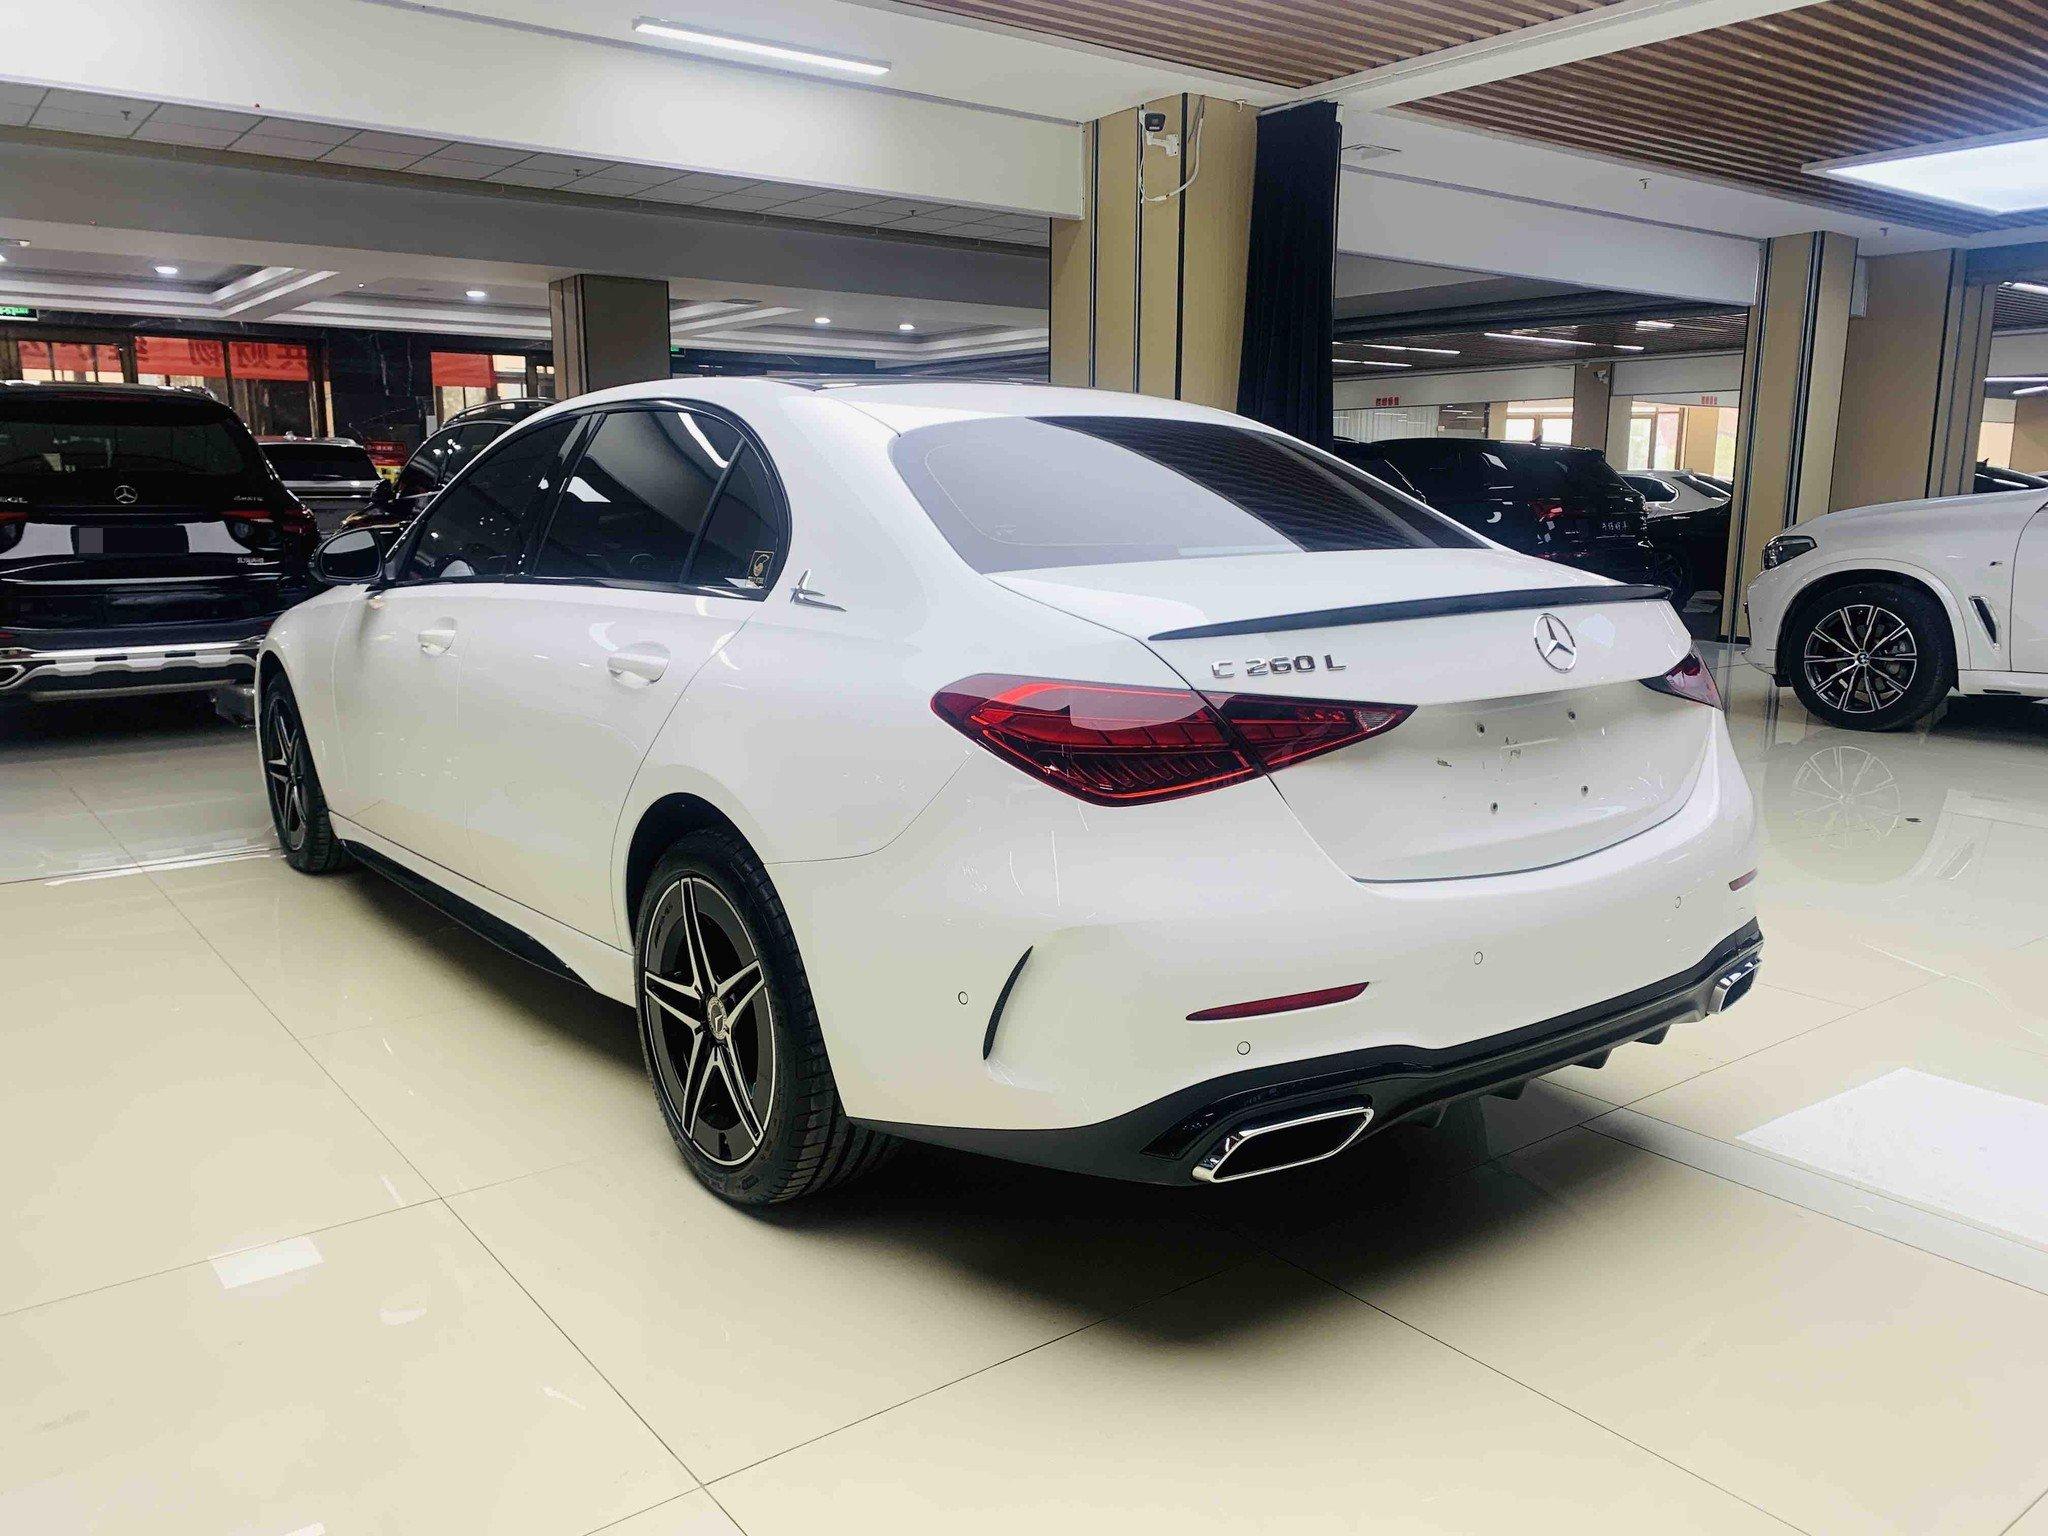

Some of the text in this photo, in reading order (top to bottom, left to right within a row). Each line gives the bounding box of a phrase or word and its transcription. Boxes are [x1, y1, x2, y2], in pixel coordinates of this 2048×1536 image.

[1211, 654, 1347, 679] C 260 L
